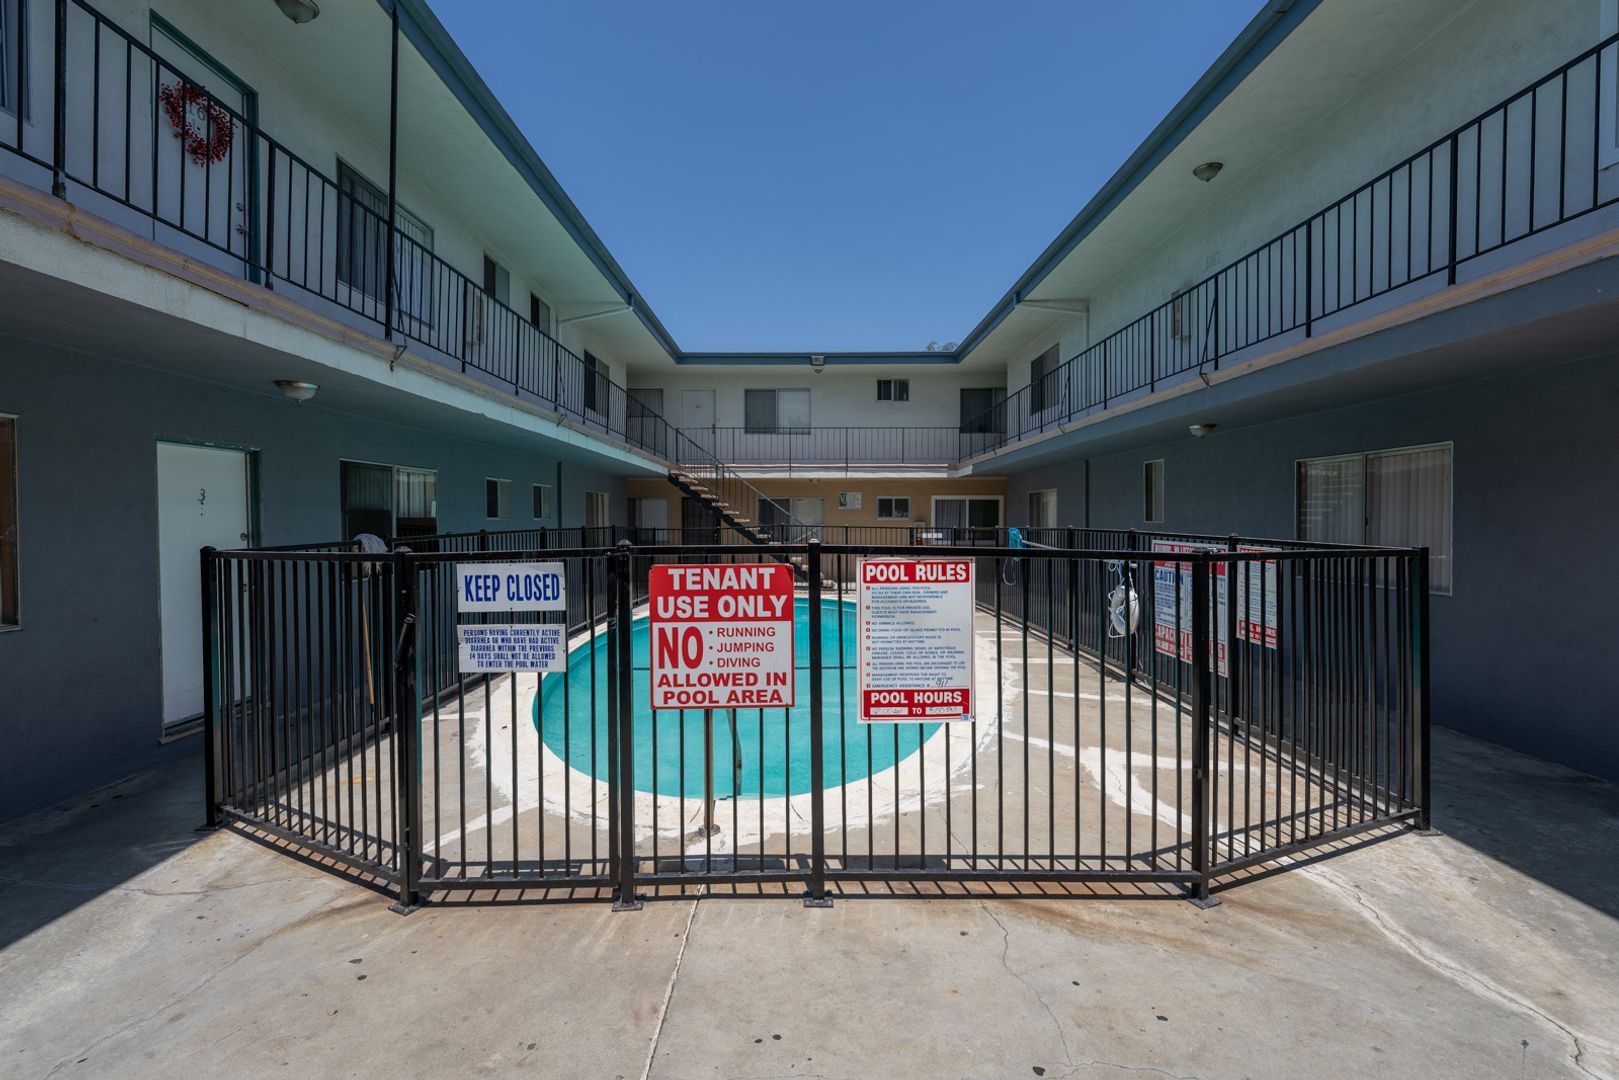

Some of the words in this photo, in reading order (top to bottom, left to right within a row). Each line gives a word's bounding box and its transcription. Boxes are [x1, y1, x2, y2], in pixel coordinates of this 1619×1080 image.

[668, 568, 775, 590] TENANT
[866, 564, 909, 581] POOL
[916, 564, 966, 581] RULES
[465, 574, 500, 602] KEEP
[507, 574, 559, 601] CLOSED
[657, 596, 709, 618] USE
[718, 595, 787, 618] ONLY
[717, 627, 776, 637] RUNNING
[658, 626, 703, 669] NO
[717, 642, 774, 652] JUMPING
[717, 658, 760, 668] DIVING
[658, 672, 758, 687] ALLOWED
[766, 672, 786, 686] IN
[664, 690, 719, 704] POOL
[726, 689, 782, 704] AREA
[871, 692, 908, 704] POOL
[914, 692, 962, 704] HOURS
